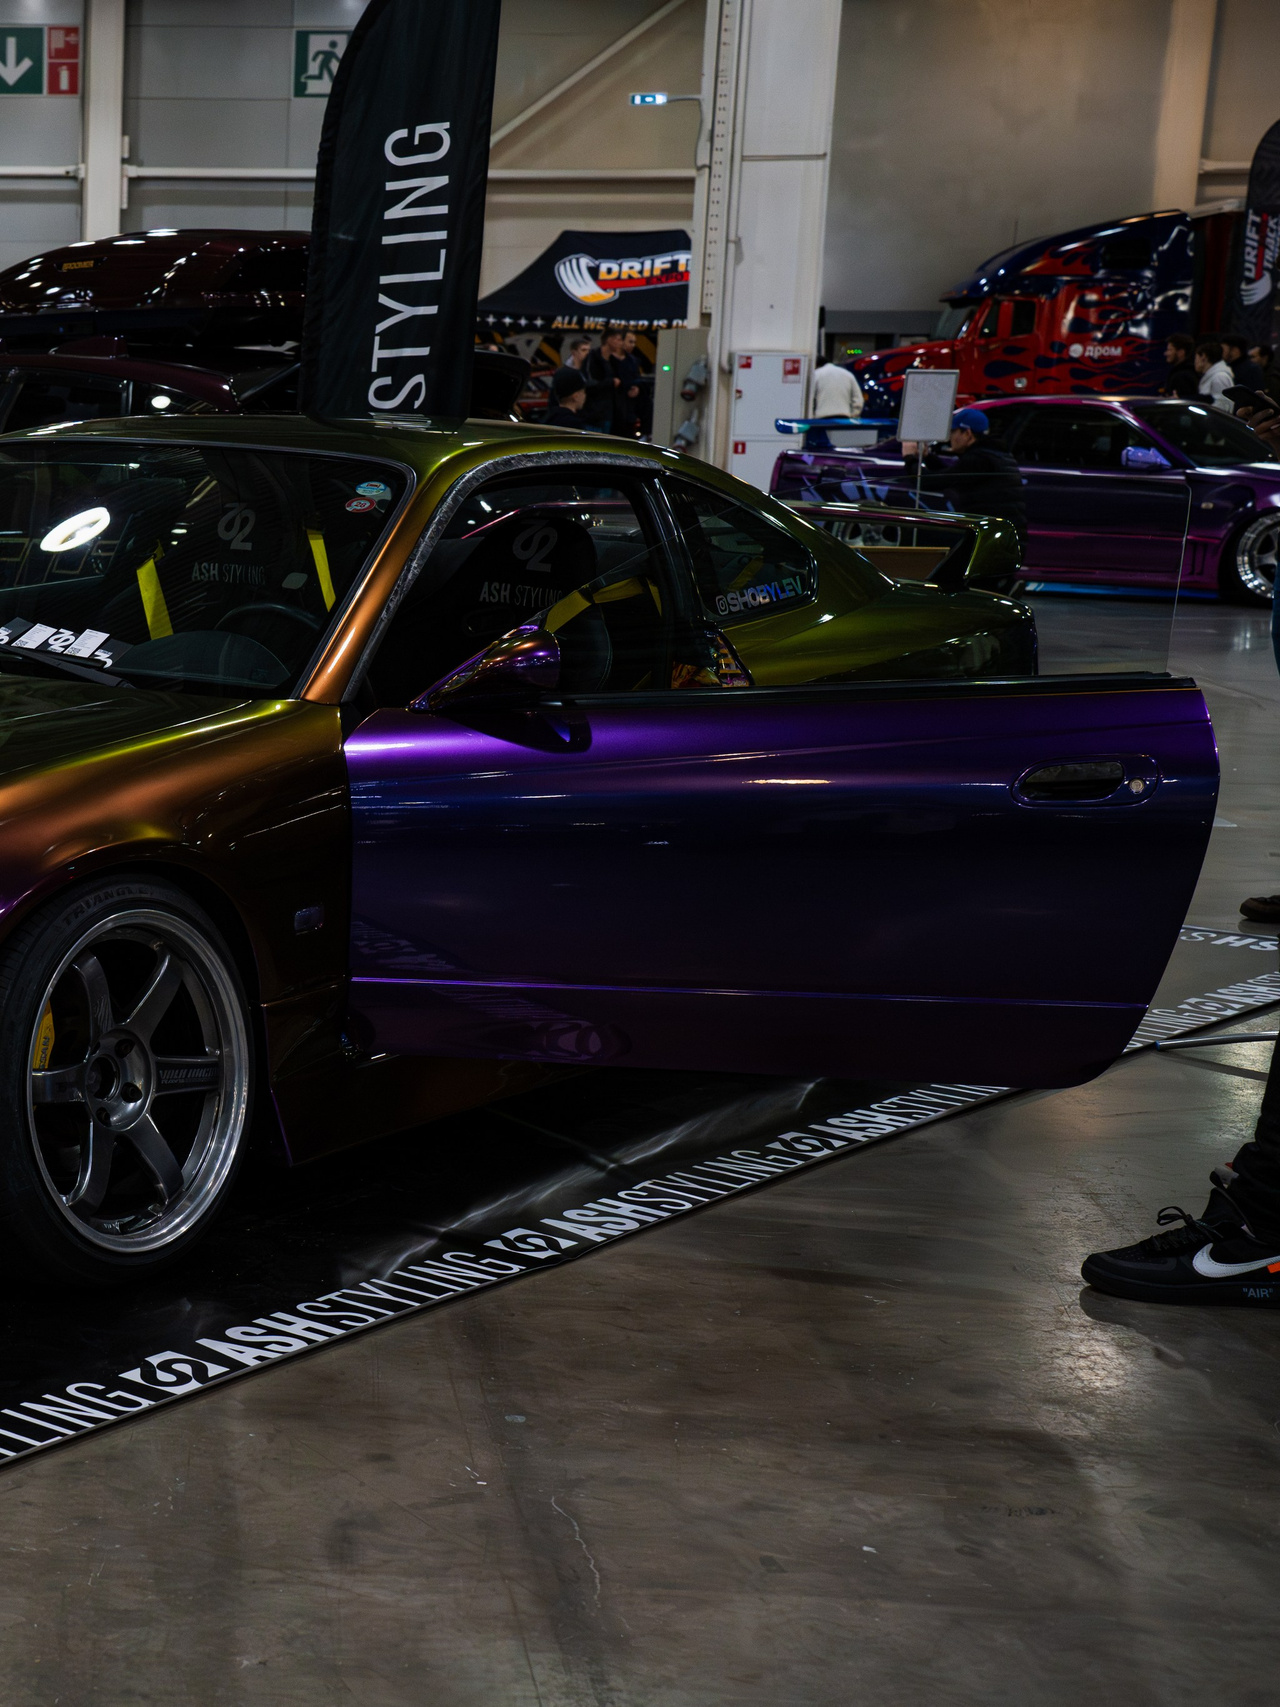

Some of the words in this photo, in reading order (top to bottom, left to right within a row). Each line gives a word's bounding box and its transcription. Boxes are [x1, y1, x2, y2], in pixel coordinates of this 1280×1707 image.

[1242, 208, 1262, 280] DRIFT
[367, 121, 451, 411] STYLING
[598, 253, 692, 280] DRIFT
[551, 314, 580, 330] ALL
[583, 315, 608, 331] WE
[651, 318, 669, 330] IS
[1084, 345, 1123, 360] дром
[191, 561, 220, 582] ASH
[222, 562, 265, 586] STYLING
[479, 580, 511, 604] ASH
[1210, 935, 1280, 952] SH
[195, 1311, 347, 1367] ASH
[315, 1251, 527, 1316] STYLING
[540, 1198, 671, 1242] ASH
[617, 1150, 805, 1211] STYLING
[809, 1109, 917, 1143] ASH
[1242, 1287, 1274, 1299] "AIR"
